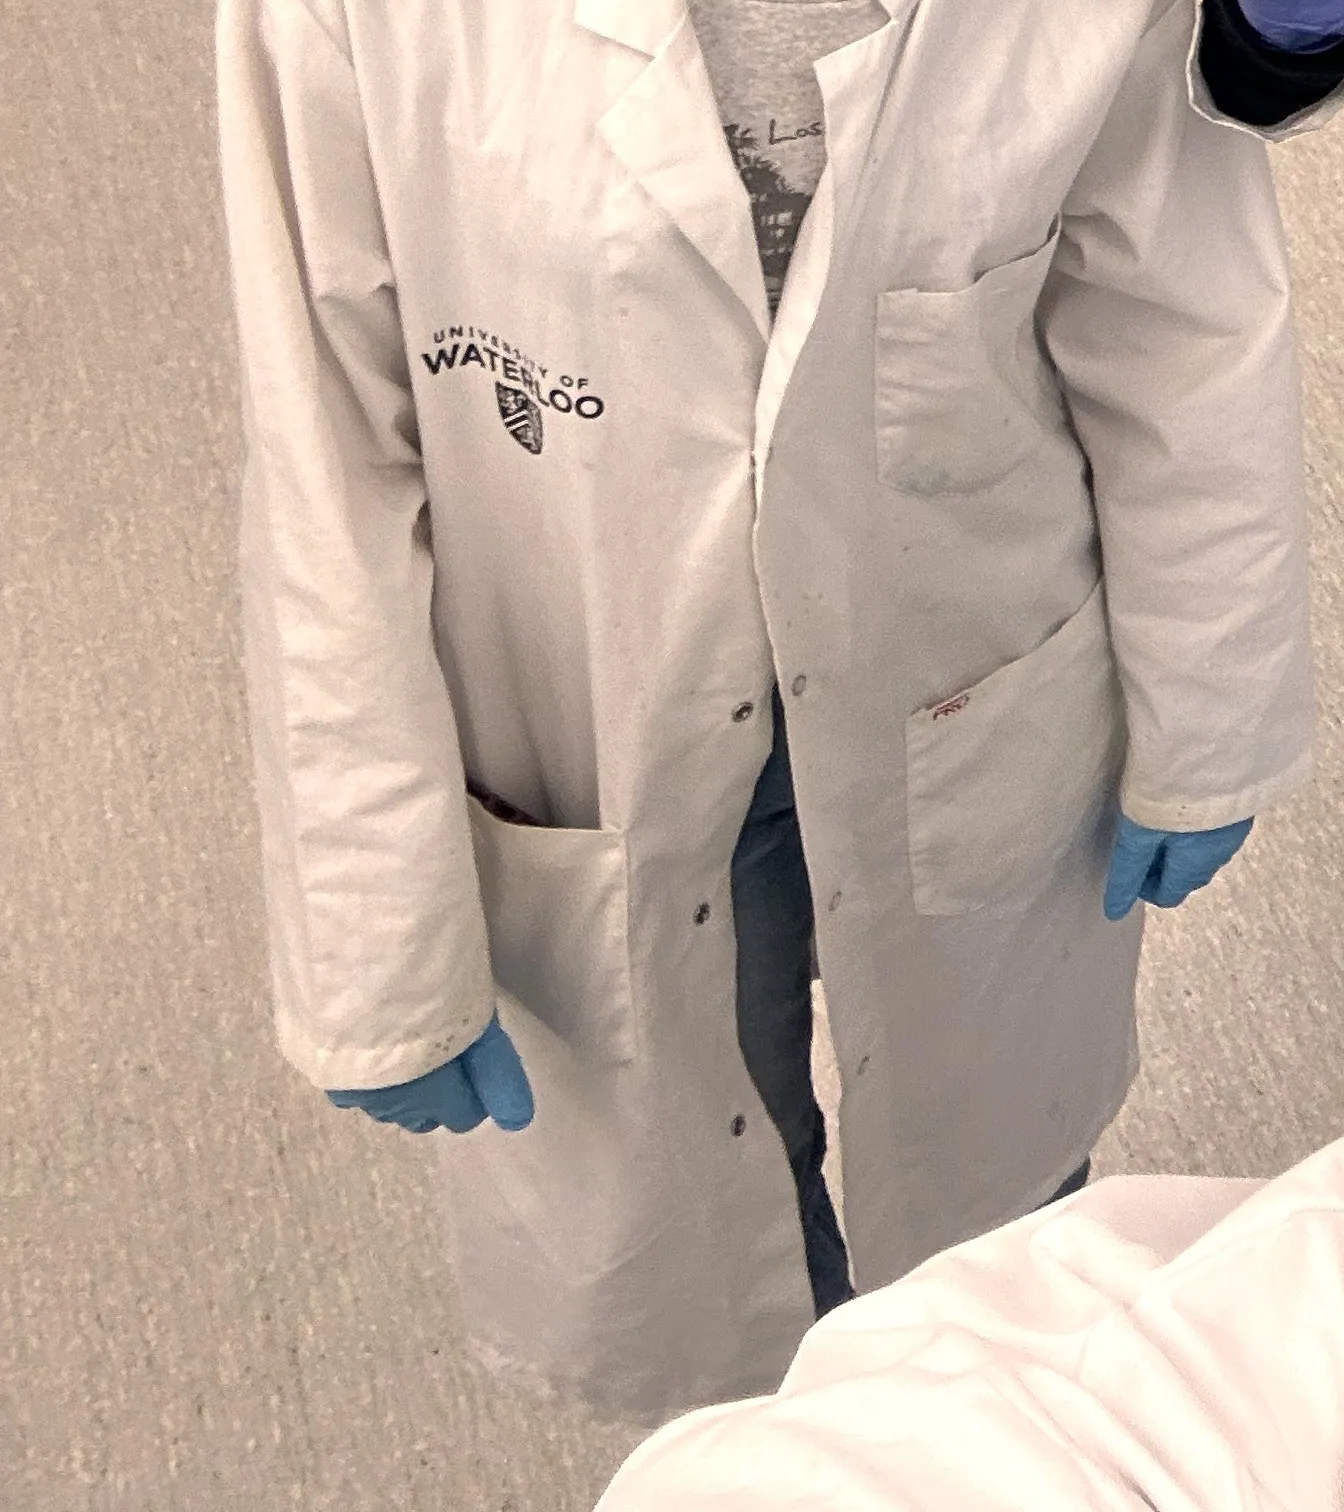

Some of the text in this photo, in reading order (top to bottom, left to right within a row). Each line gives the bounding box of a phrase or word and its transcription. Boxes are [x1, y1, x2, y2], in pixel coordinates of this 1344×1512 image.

[421, 343, 605, 419] WATERLOO
[433, 325, 589, 390] UNIVERSITY OF
